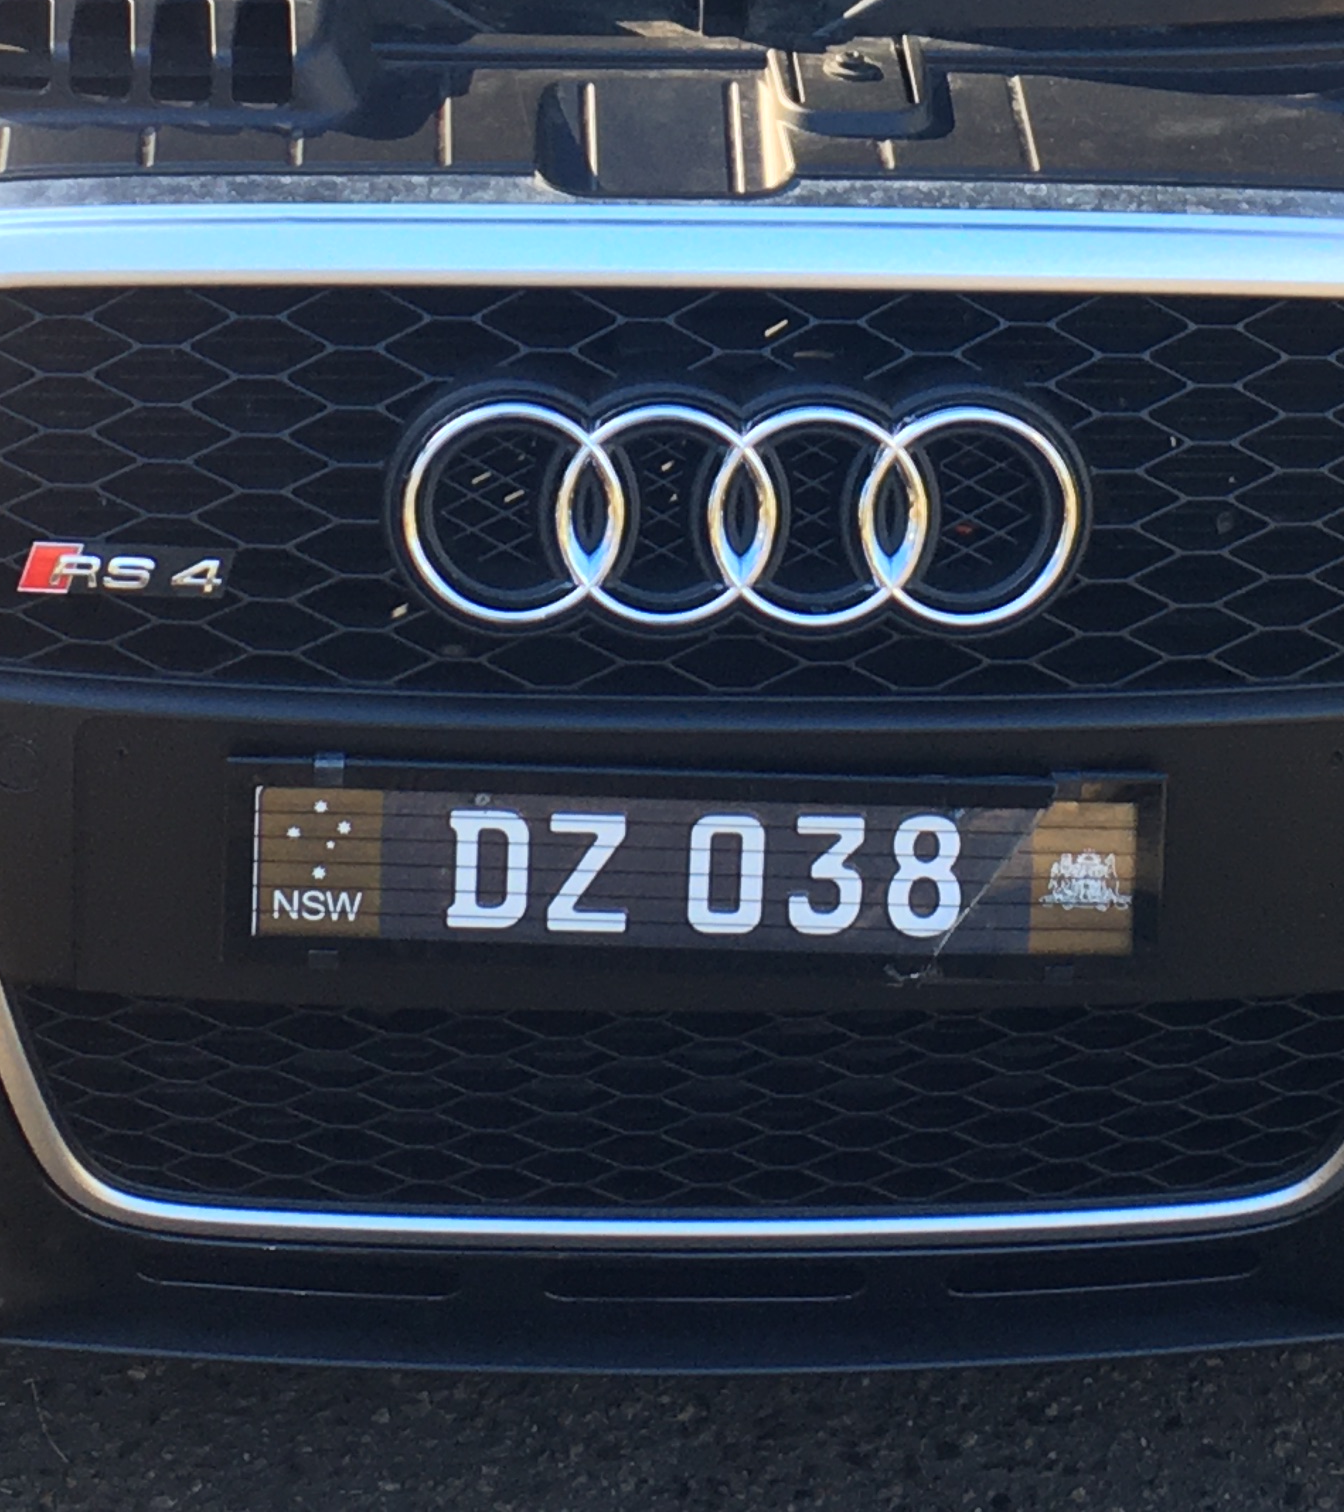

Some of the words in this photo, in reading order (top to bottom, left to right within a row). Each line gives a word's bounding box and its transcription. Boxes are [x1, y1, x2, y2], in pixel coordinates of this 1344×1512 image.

[49, 554, 156, 589] RS
[170, 558, 223, 593] 4
[446, 808, 628, 933] DZ
[686, 813, 962, 939] 038
[272, 888, 363, 922] NSW
